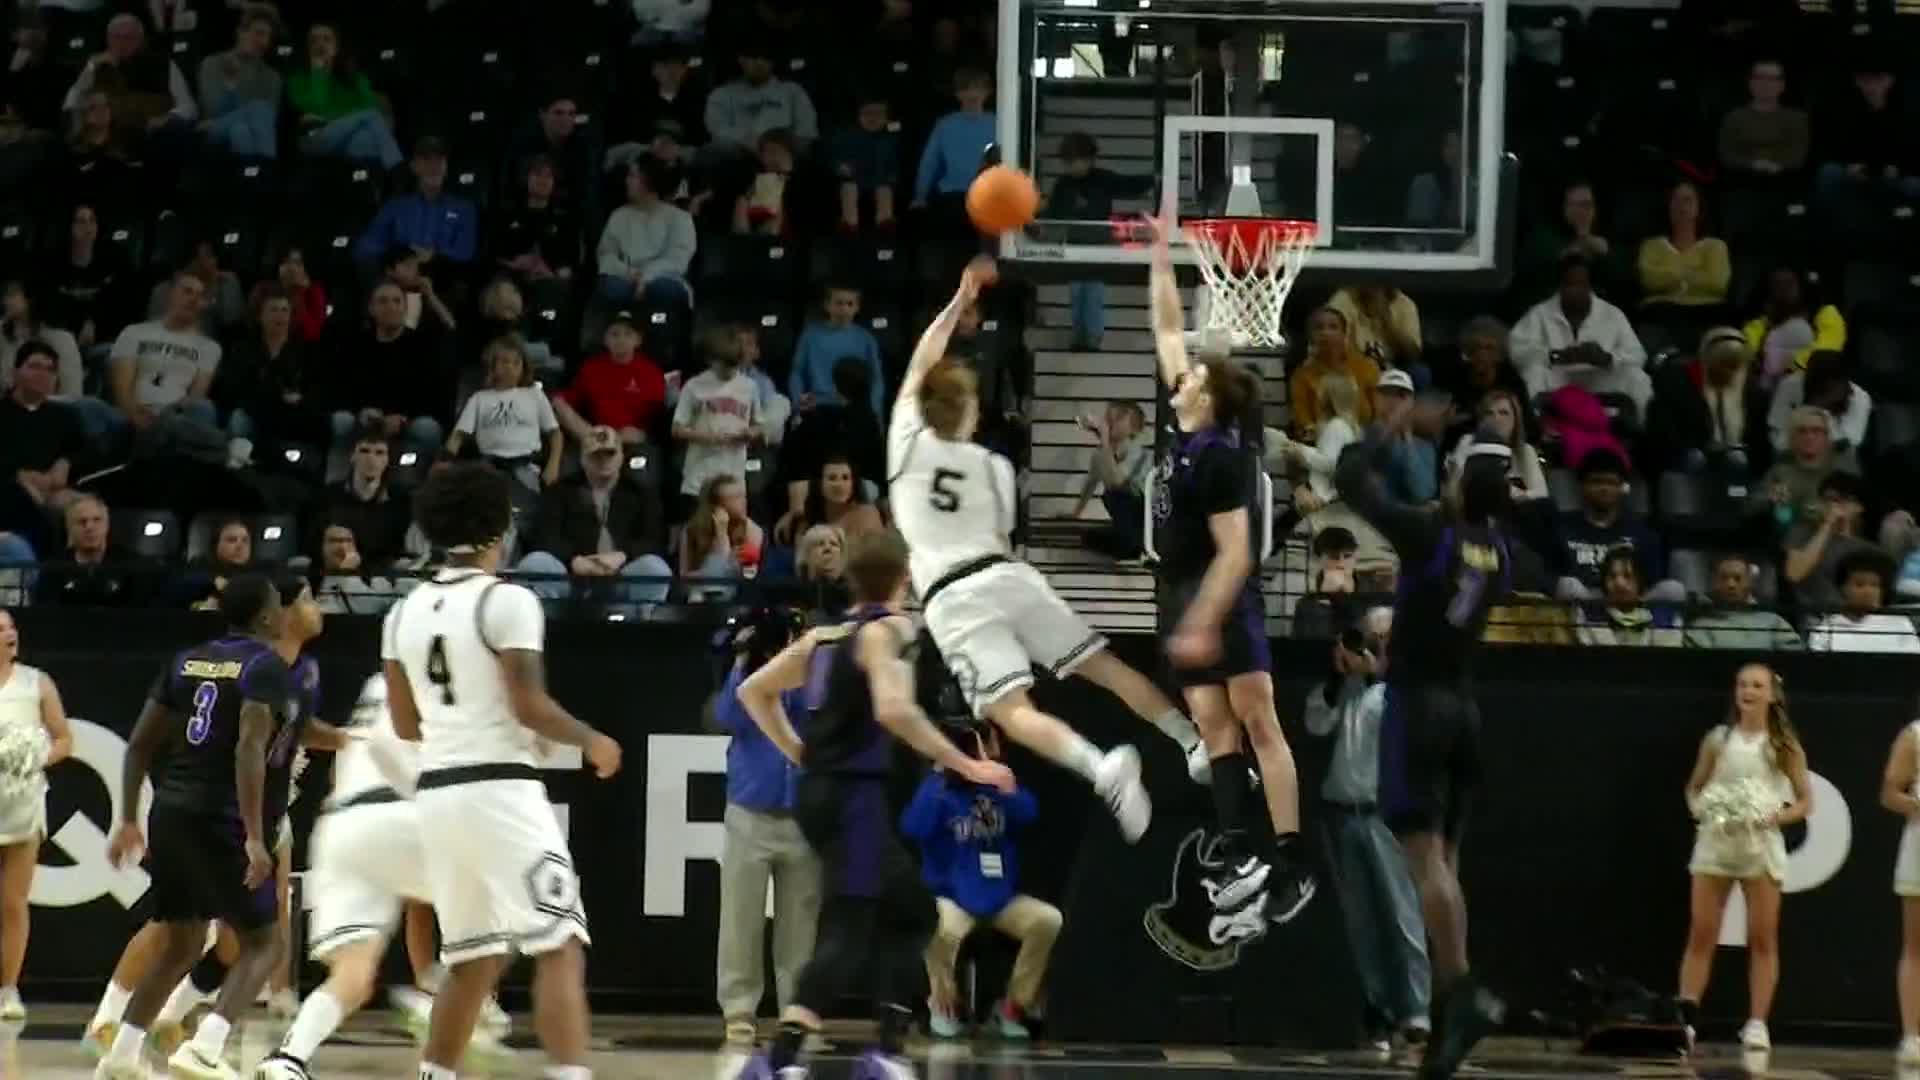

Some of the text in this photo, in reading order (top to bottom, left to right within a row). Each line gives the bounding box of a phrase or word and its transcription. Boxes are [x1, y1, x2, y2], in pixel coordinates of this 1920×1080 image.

[929, 466, 966, 513] 5
[426, 631, 455, 706] 4
[186, 680, 218, 744] 3
